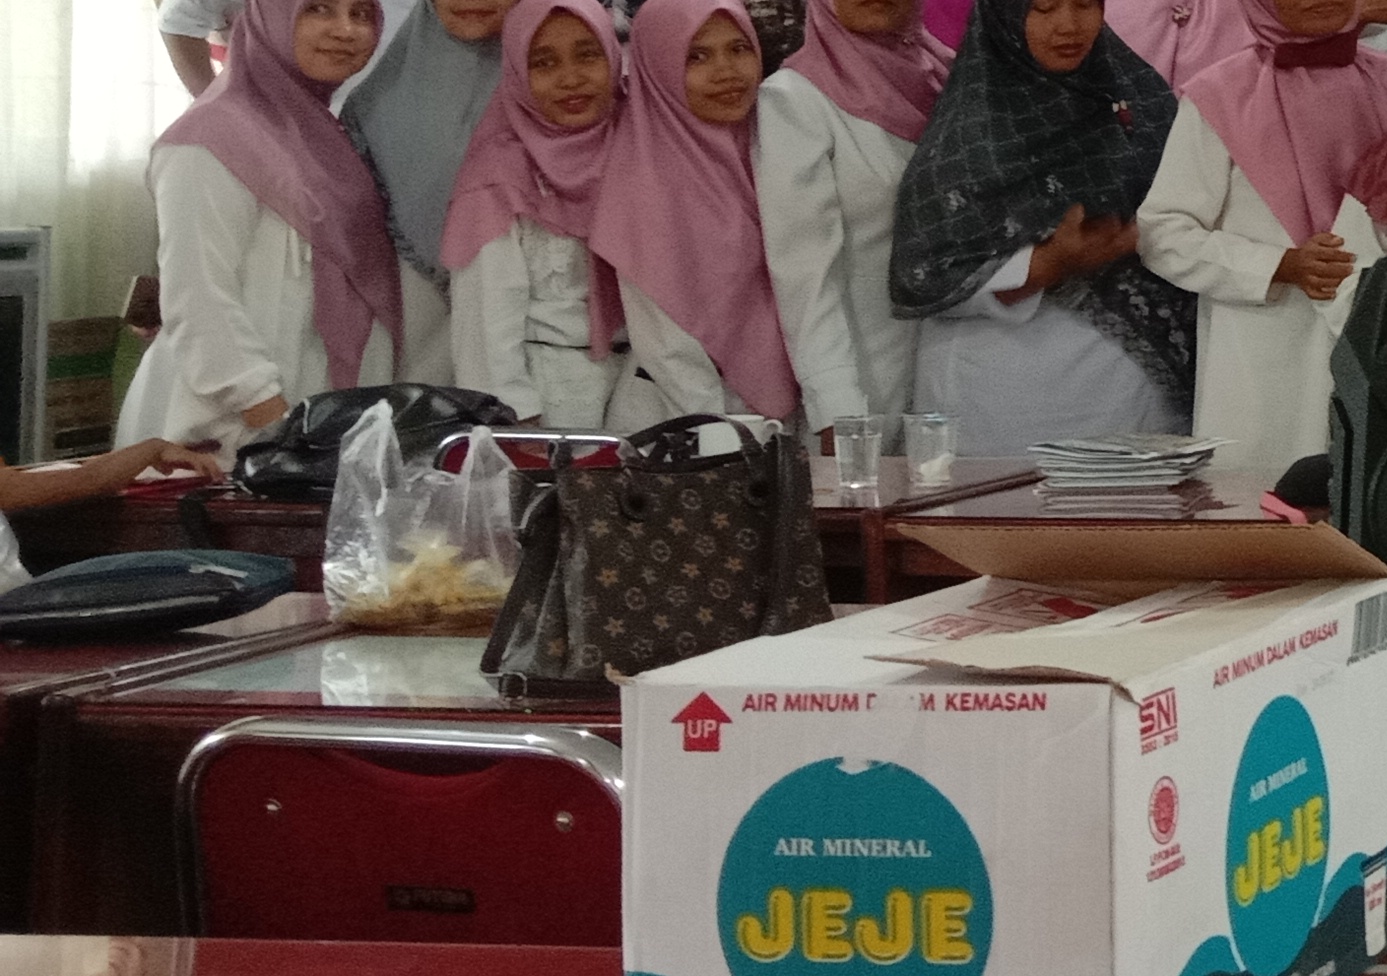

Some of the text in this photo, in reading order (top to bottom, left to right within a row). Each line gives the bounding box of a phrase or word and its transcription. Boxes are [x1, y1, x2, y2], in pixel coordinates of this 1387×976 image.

[1213, 666, 1230, 689] AIR
[1232, 652, 1264, 681] MINUM
[1266, 636, 1295, 667] DALAM
[1299, 619, 1338, 651] KEMASAN
[742, 693, 777, 712] AIR
[783, 693, 859, 712] MINUM
[945, 693, 1047, 711] KEMASAN
[1140, 691, 1177, 737] SNI
[687, 720, 717, 739] UP
[774, 838, 932, 858] AIR MINERAL
[1233, 795, 1324, 907] JEJE
[737, 887, 974, 964] JEJE
